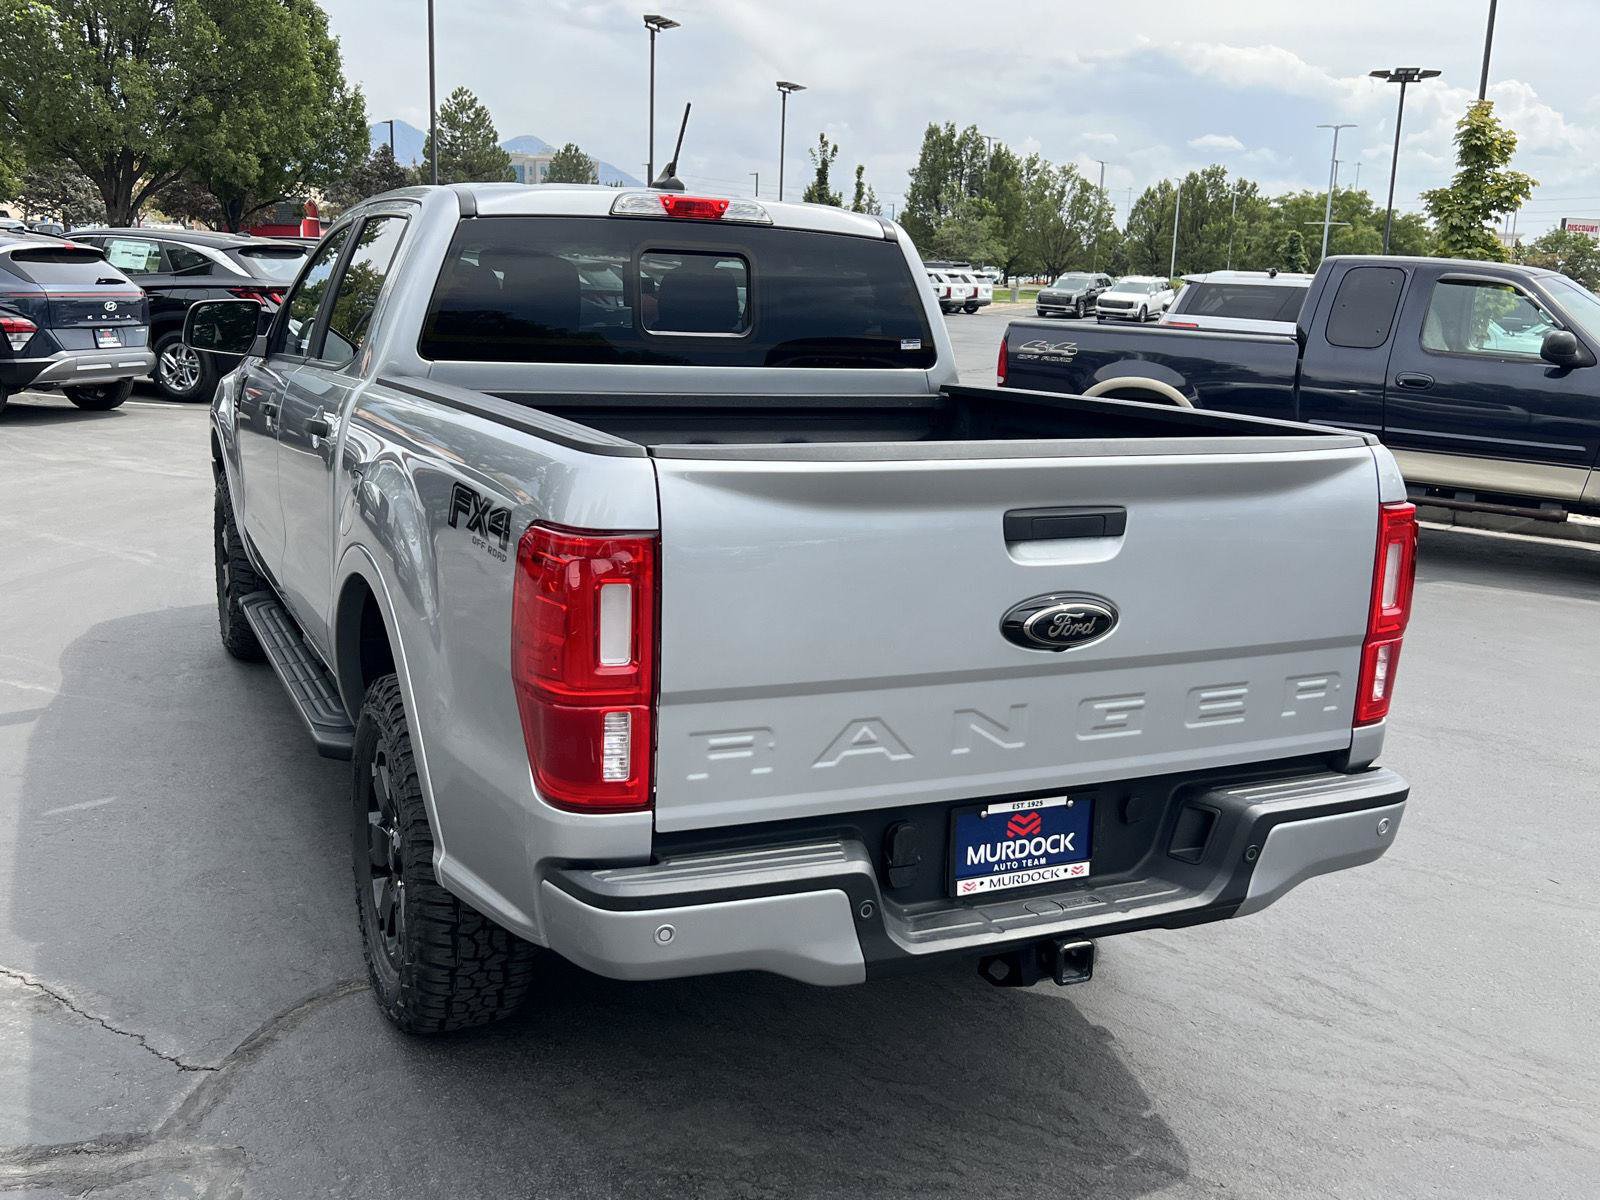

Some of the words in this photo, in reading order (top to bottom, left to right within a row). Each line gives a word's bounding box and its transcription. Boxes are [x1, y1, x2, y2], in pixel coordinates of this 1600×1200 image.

[447, 481, 512, 552] FX4
[471, 535, 487, 550] OFF
[487, 545, 507, 563] ROAD
[1047, 612, 1097, 638] Ford
[686, 671, 1341, 781] RANGER
[1027, 800, 1044, 808] 1925
[966, 832, 1075, 866] MURDOCK
[993, 861, 1018, 872] AUTO
[1022, 857, 1047, 867] TEAM
[989, 868, 1060, 889] MURDOCK
